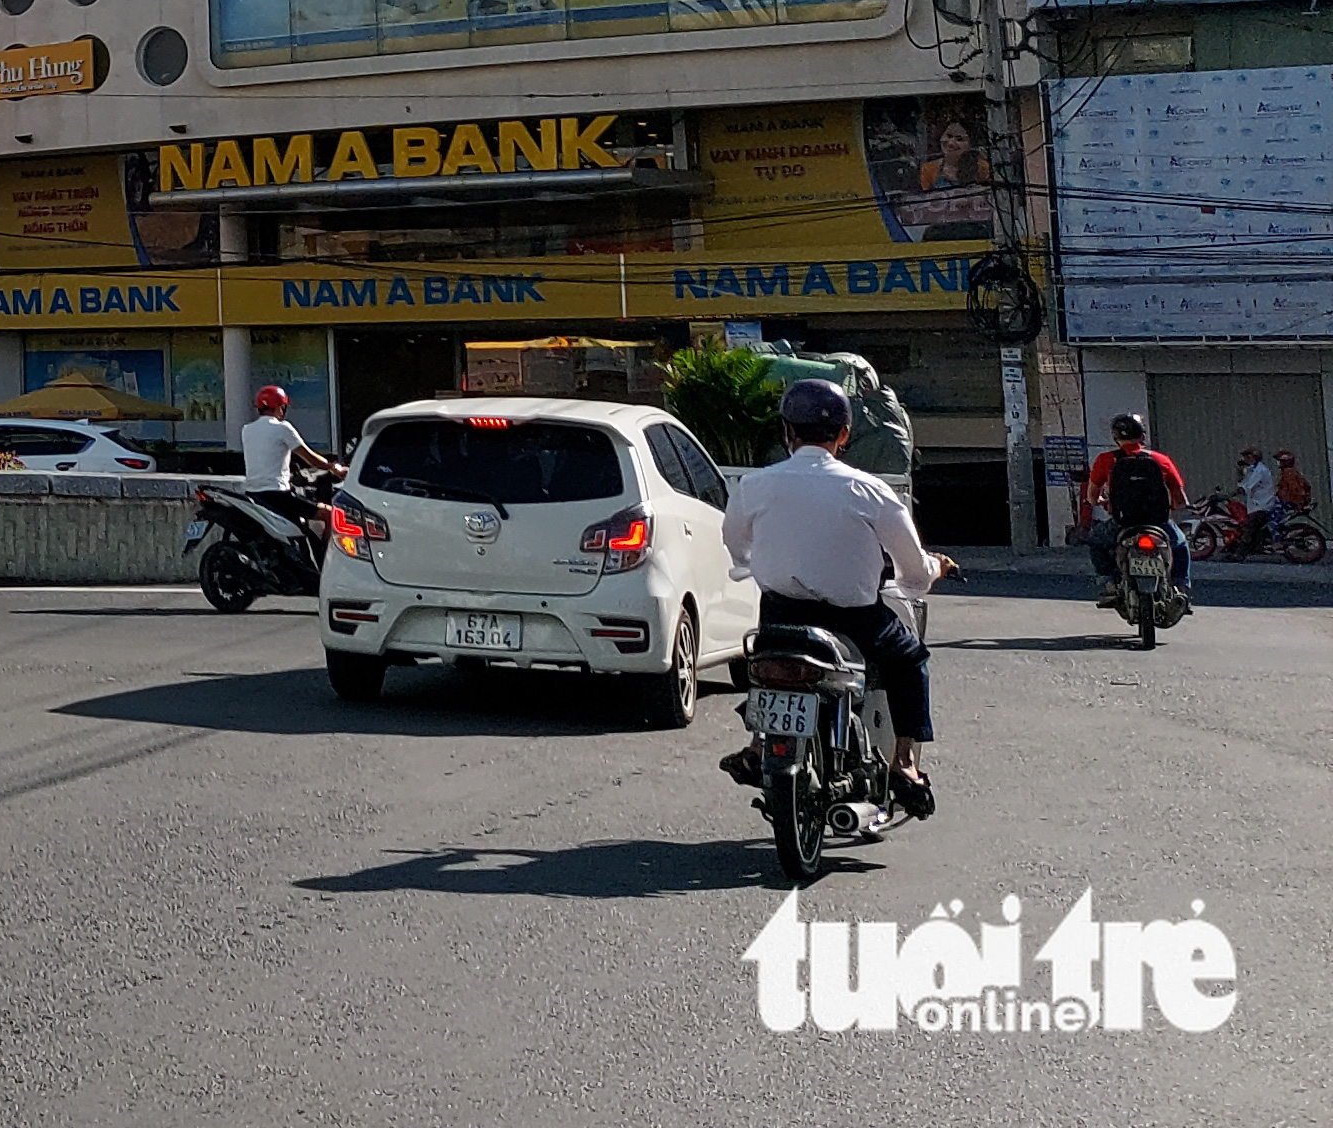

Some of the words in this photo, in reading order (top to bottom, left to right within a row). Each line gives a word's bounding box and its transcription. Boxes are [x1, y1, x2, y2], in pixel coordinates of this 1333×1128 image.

[28, 55, 85, 85] Hung
[158, 133, 315, 192] NAM
[326, 130, 380, 182] A
[392, 113, 626, 178] BANK
[709, 149, 741, 164] VAY
[745, 145, 784, 162] KINH
[789, 142, 850, 159] DOANH
[282, 278, 377, 310] NAM
[386, 276, 415, 308] A
[423, 272, 546, 306] BANK
[673, 266, 790, 300] NAM
[801, 264, 837, 297] A
[48, 287, 74, 315] A
[79, 284, 181, 314] BANK
[467, 613, 499, 629] 67A
[456, 629, 512, 648] 163.04
[757, 690, 807, 714] 67-F4
